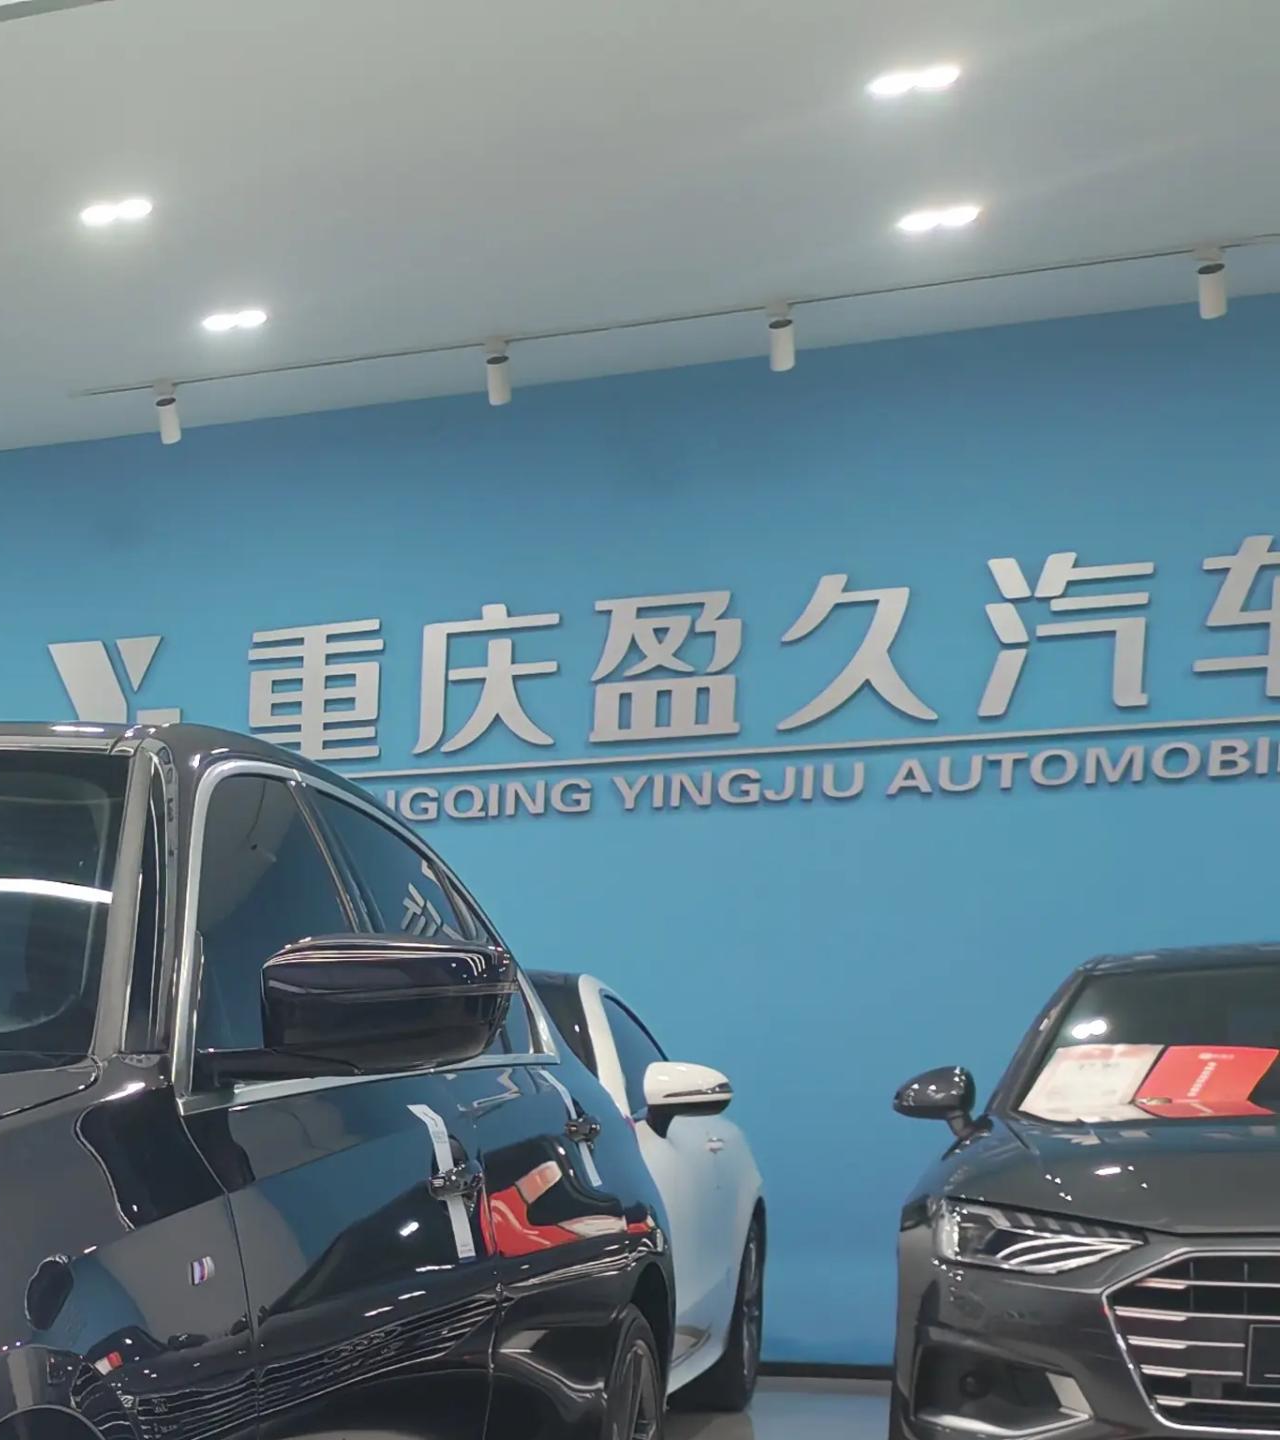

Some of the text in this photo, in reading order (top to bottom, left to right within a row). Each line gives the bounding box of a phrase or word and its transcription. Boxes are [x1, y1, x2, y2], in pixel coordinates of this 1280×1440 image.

[386, 735, 1280, 822] GQING YINGJIU AUTOMOBI
